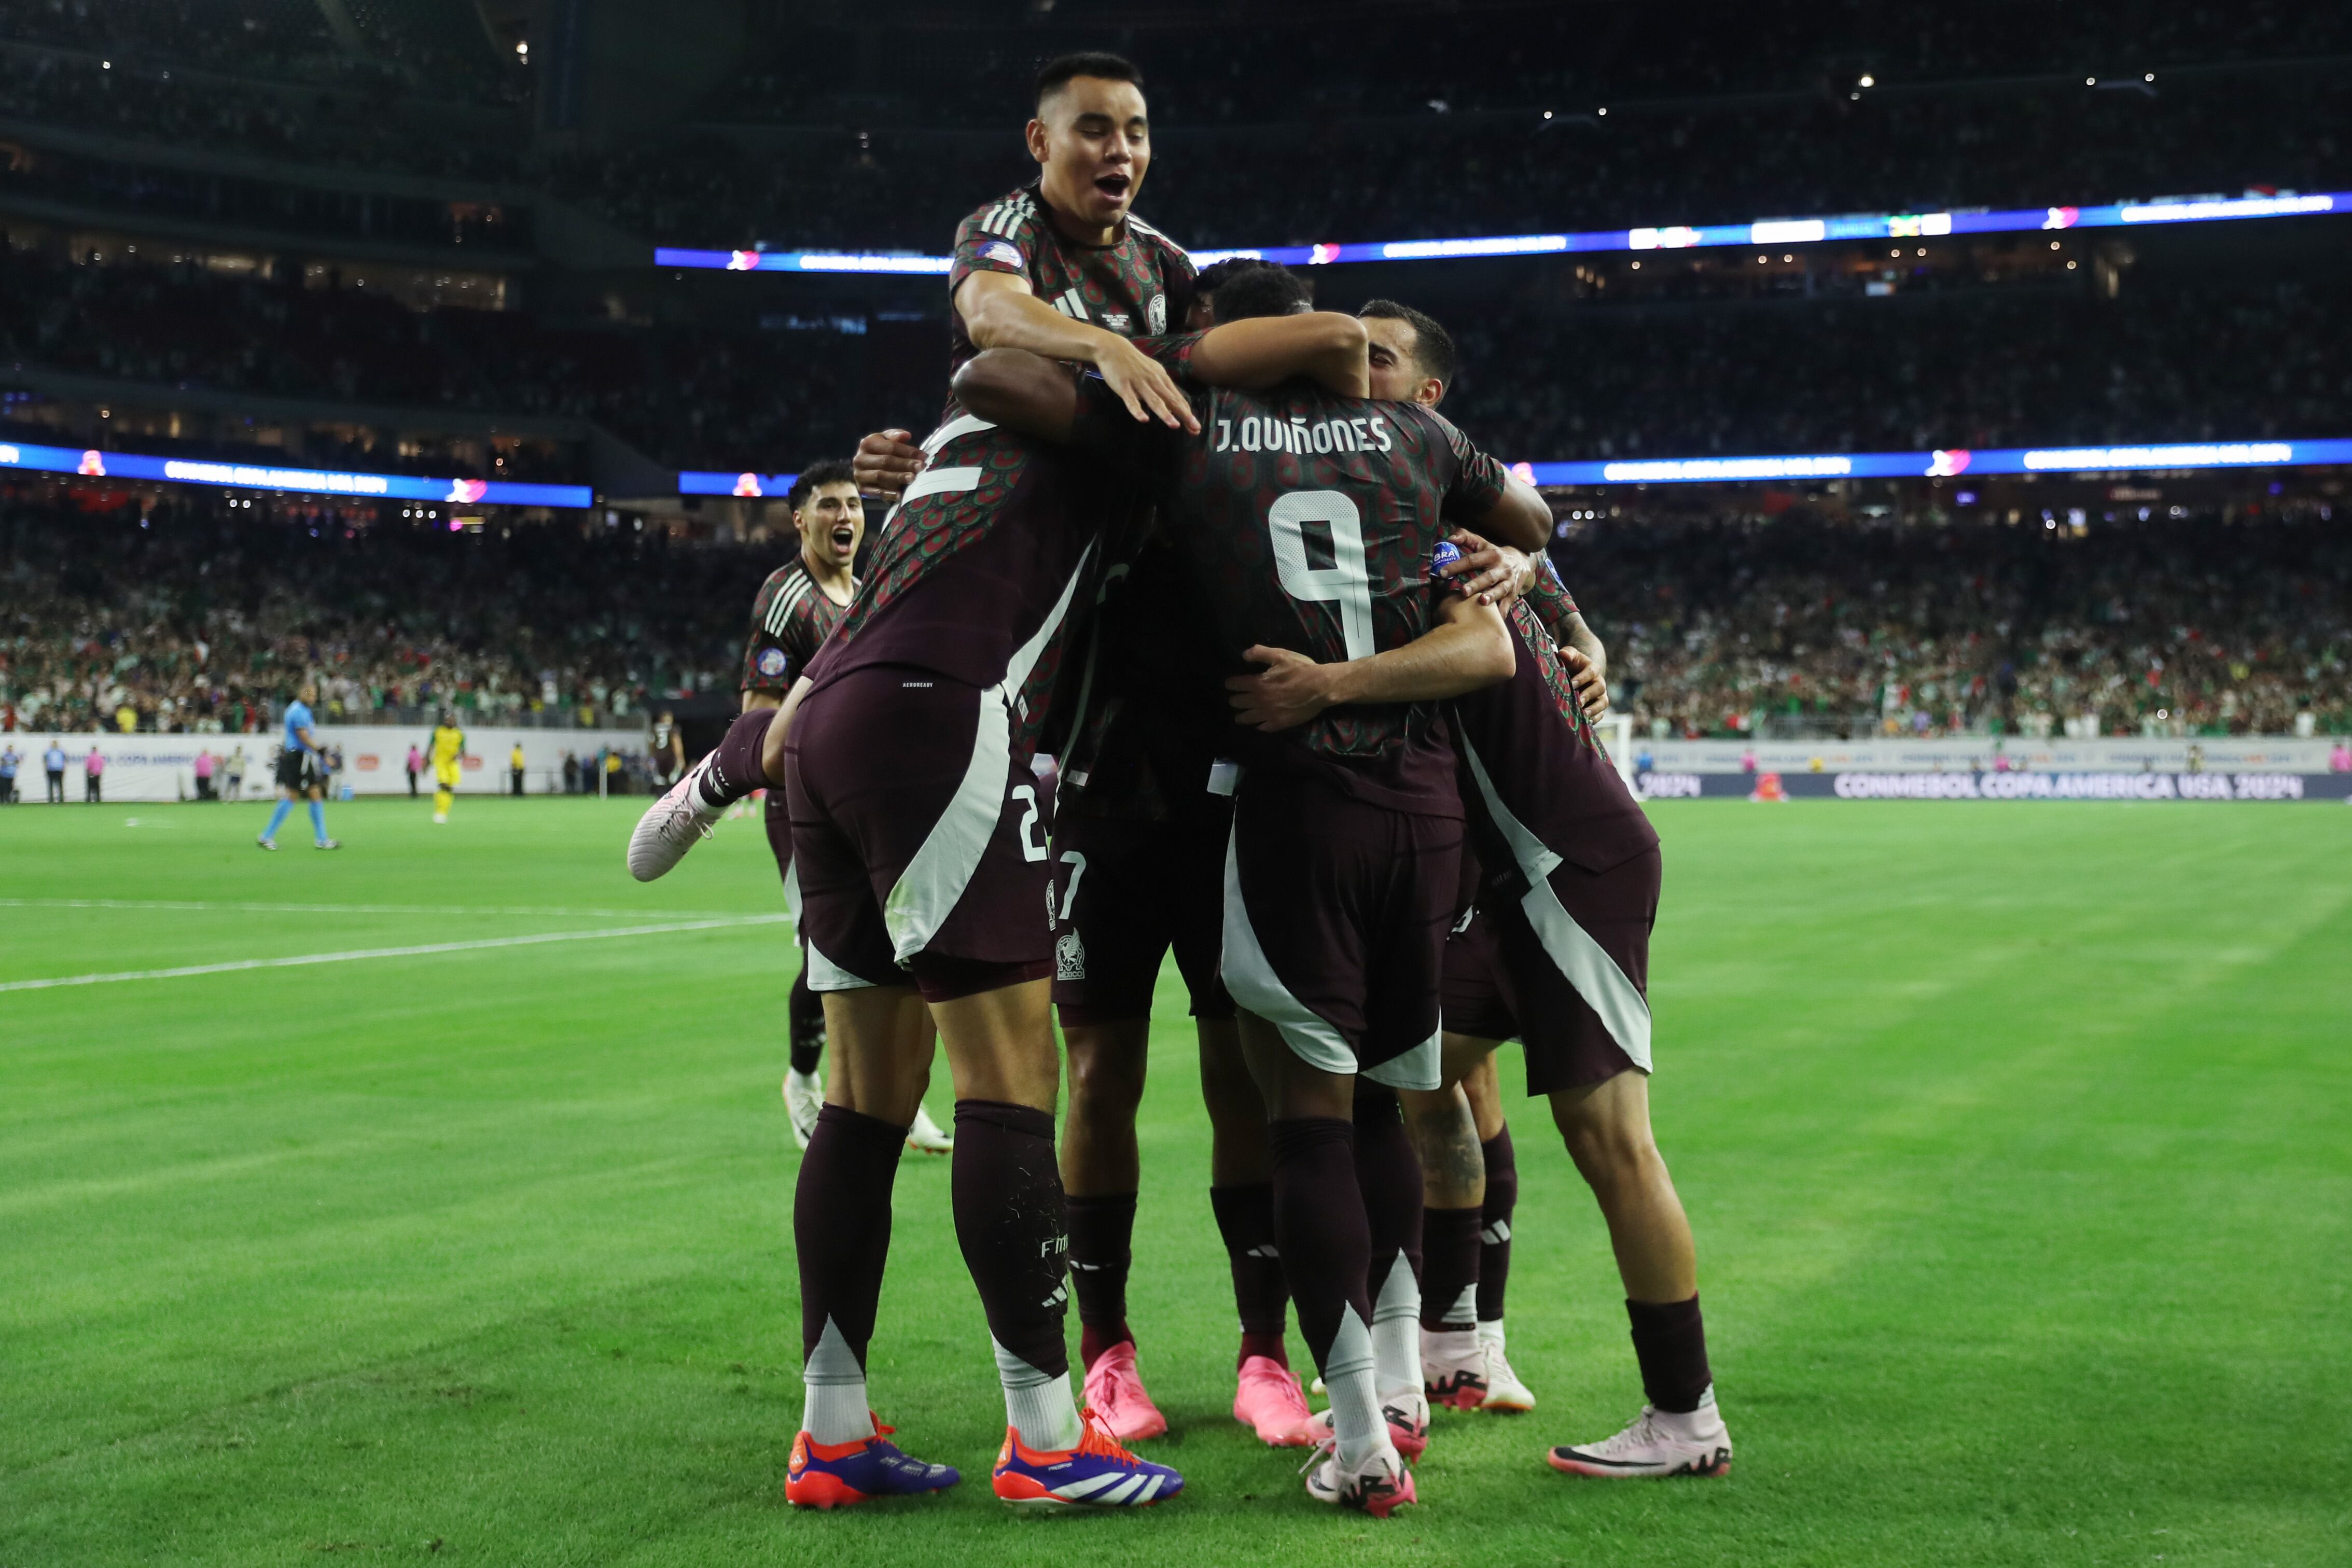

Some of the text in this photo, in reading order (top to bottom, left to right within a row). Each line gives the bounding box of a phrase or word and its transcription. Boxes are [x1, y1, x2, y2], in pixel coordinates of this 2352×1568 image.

[1217, 416, 1391, 455] J.QUIÑONES
[1269, 490, 1375, 661] 9
[1834, 773, 2304, 800] CONMEBOL COPA AMERICA USA 2024
[1012, 785, 1048, 862] 2
[1058, 850, 1087, 919] 7
